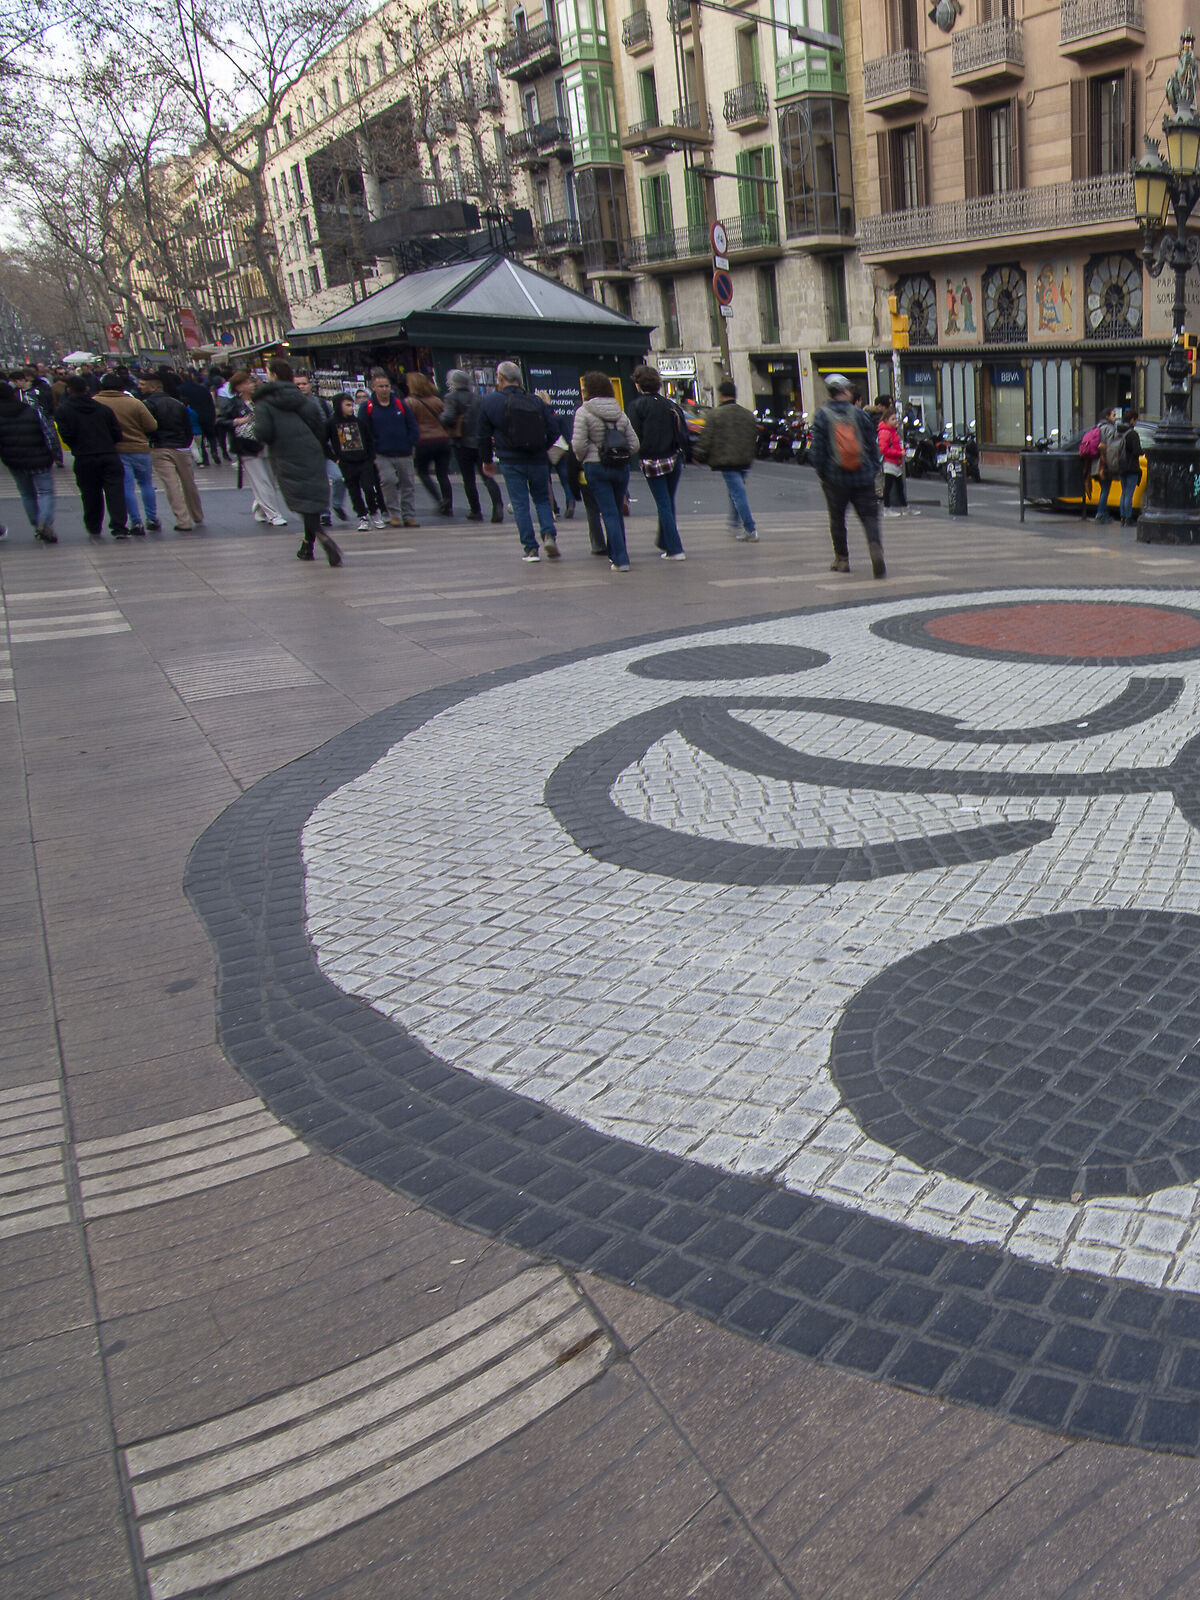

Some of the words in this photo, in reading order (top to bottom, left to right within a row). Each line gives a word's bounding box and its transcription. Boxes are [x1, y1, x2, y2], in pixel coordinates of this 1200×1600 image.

[1156, 278, 1200, 288] PARAS
[1156, 293, 1200, 304] SOMBLAS
[915, 372, 931, 382] BBVA
[1001, 371, 1020, 382] BBVA
[557, 388, 580, 397] pedido
